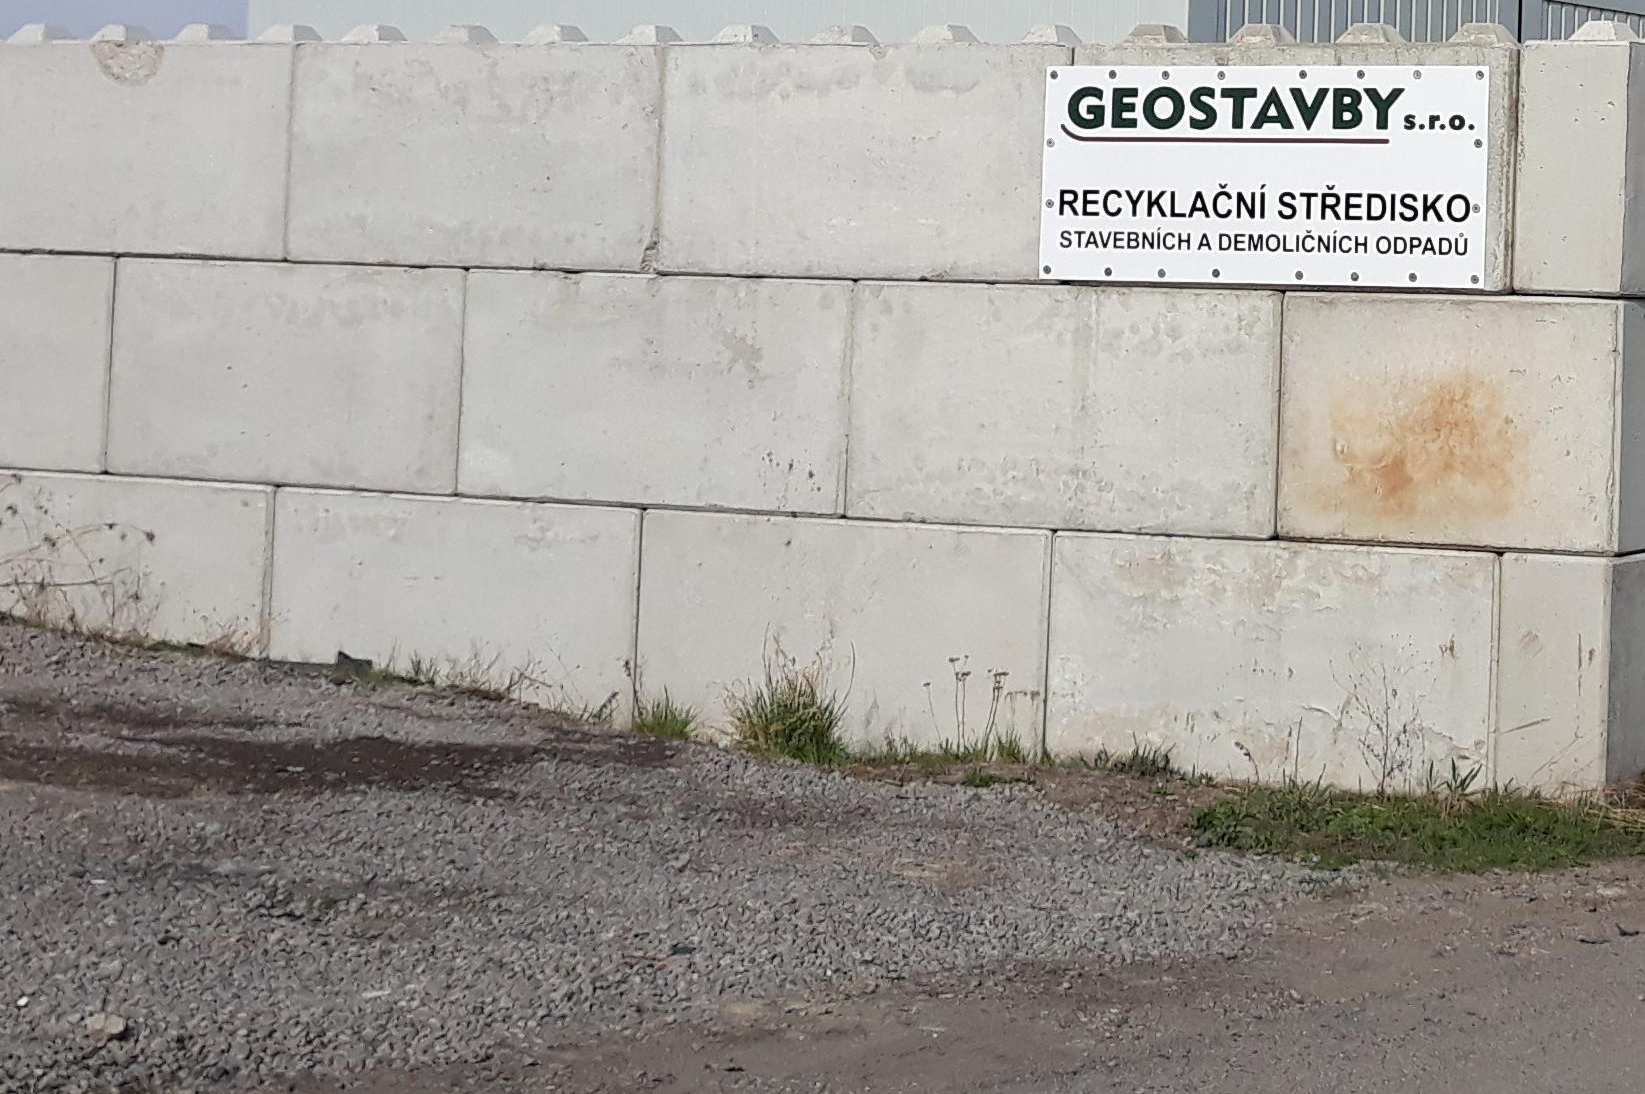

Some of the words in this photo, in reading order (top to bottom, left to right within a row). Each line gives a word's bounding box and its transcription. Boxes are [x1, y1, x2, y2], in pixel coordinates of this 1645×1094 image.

[1067, 86, 1406, 131] GEOSTAVBY
[1403, 110, 1476, 131] s.r.o.
[1058, 183, 1267, 220] RECYKLAČNÍ
[1277, 184, 1471, 223] STŘEDISKO
[1059, 226, 1191, 251] STAVEBNÍCH
[1197, 232, 1212, 251] A
[1218, 229, 1368, 254] DEMOLIČNÍCH
[1375, 232, 1468, 256] ODPADŮ
